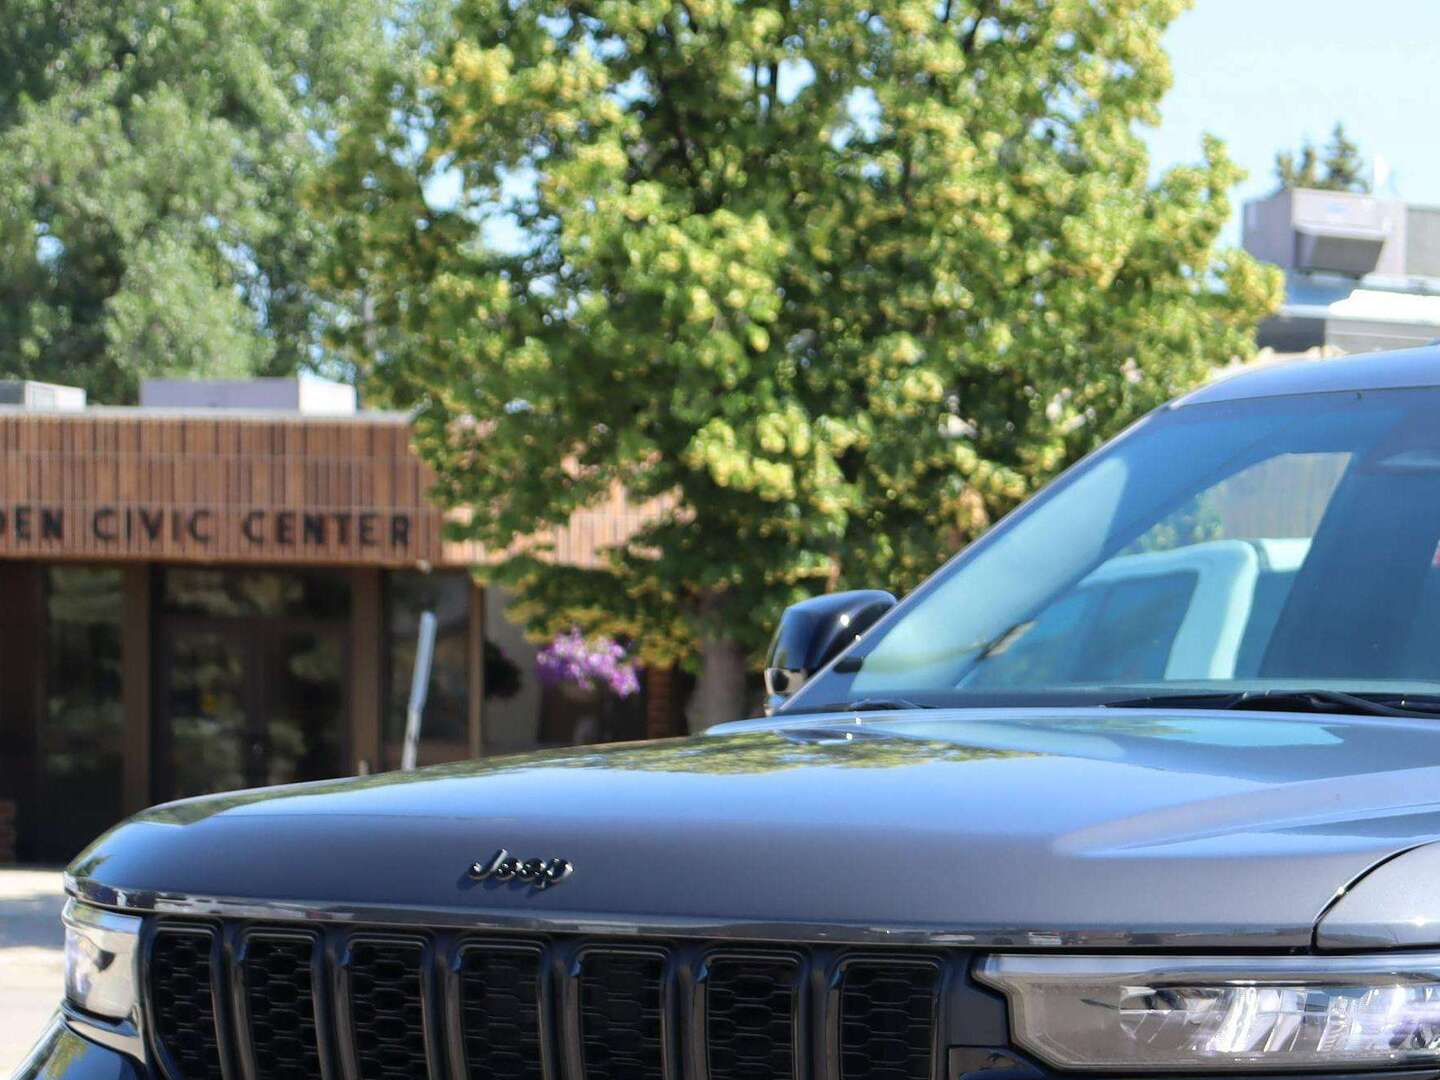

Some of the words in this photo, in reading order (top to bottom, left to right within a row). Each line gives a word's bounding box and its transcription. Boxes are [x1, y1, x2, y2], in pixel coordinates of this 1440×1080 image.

[93, 507, 213, 543] CIVIC
[243, 509, 410, 546] CENTER
[468, 848, 574, 891] Jeep
